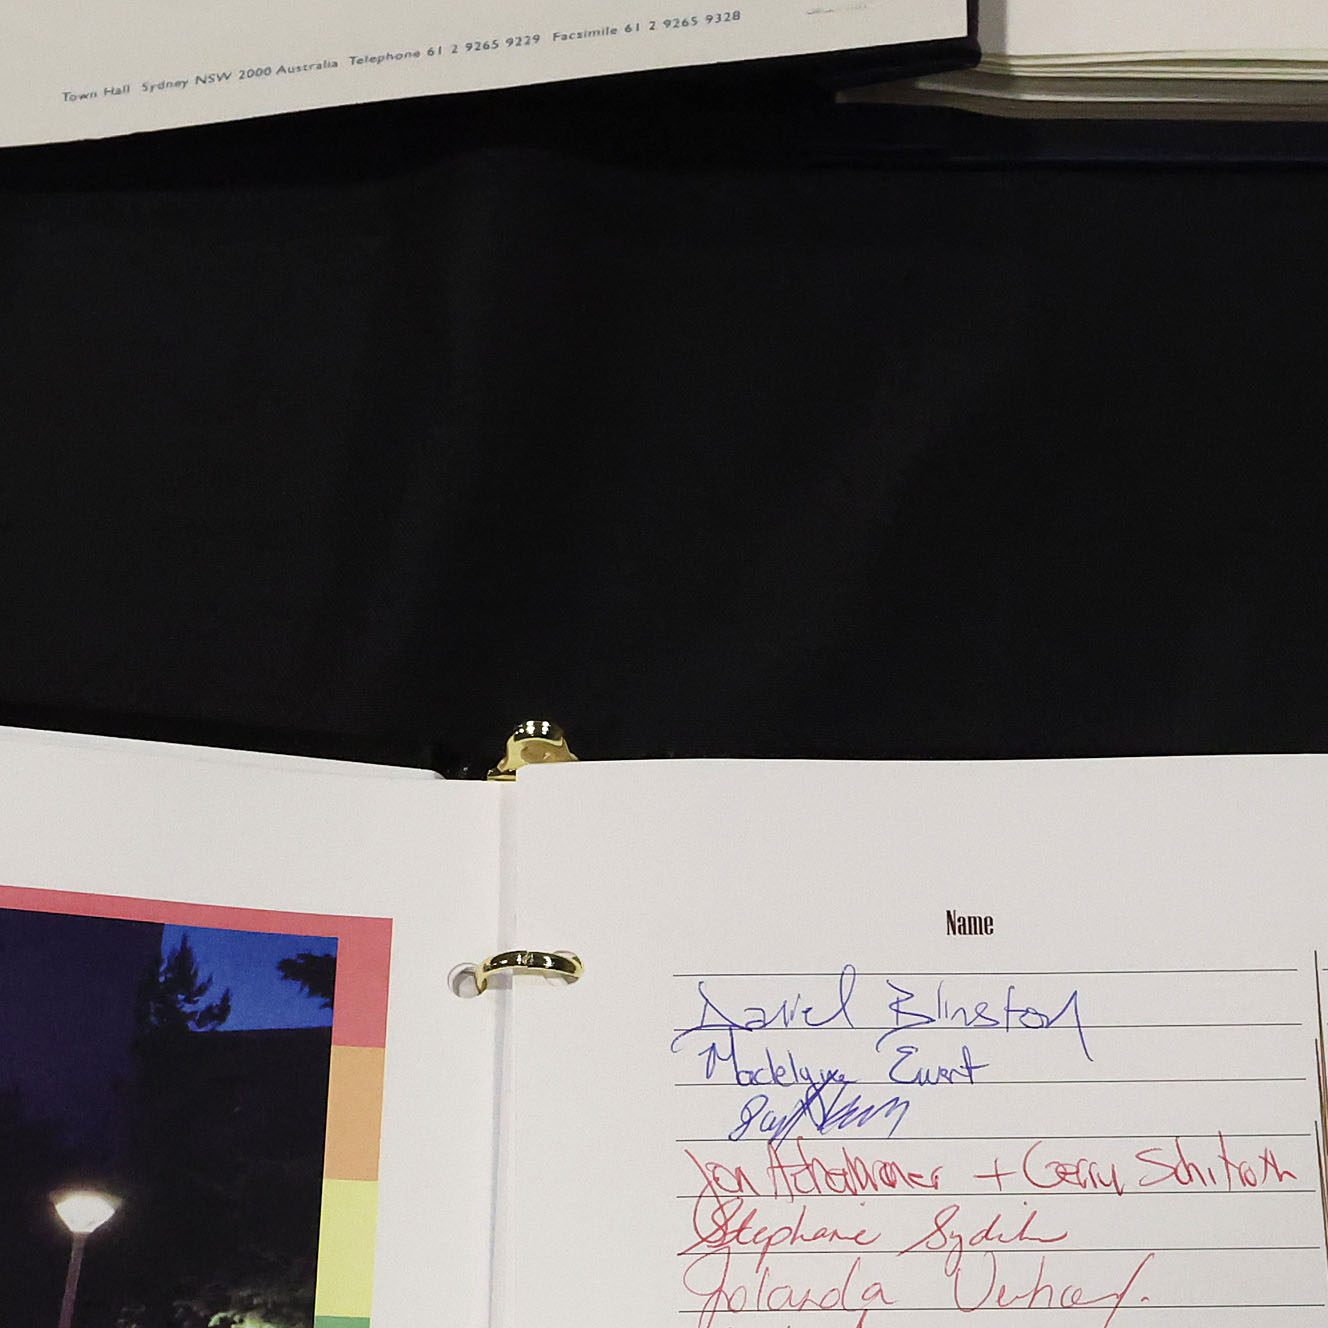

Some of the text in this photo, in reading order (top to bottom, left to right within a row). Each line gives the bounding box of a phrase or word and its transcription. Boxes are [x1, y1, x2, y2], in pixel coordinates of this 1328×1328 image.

[61, 10, 742, 103] Town Hall Sydney NSW 2000 Australia Telephone 61 2 9265 9229 Facsimile 61 2 9265 9328
[945, 909, 995, 936] Name
